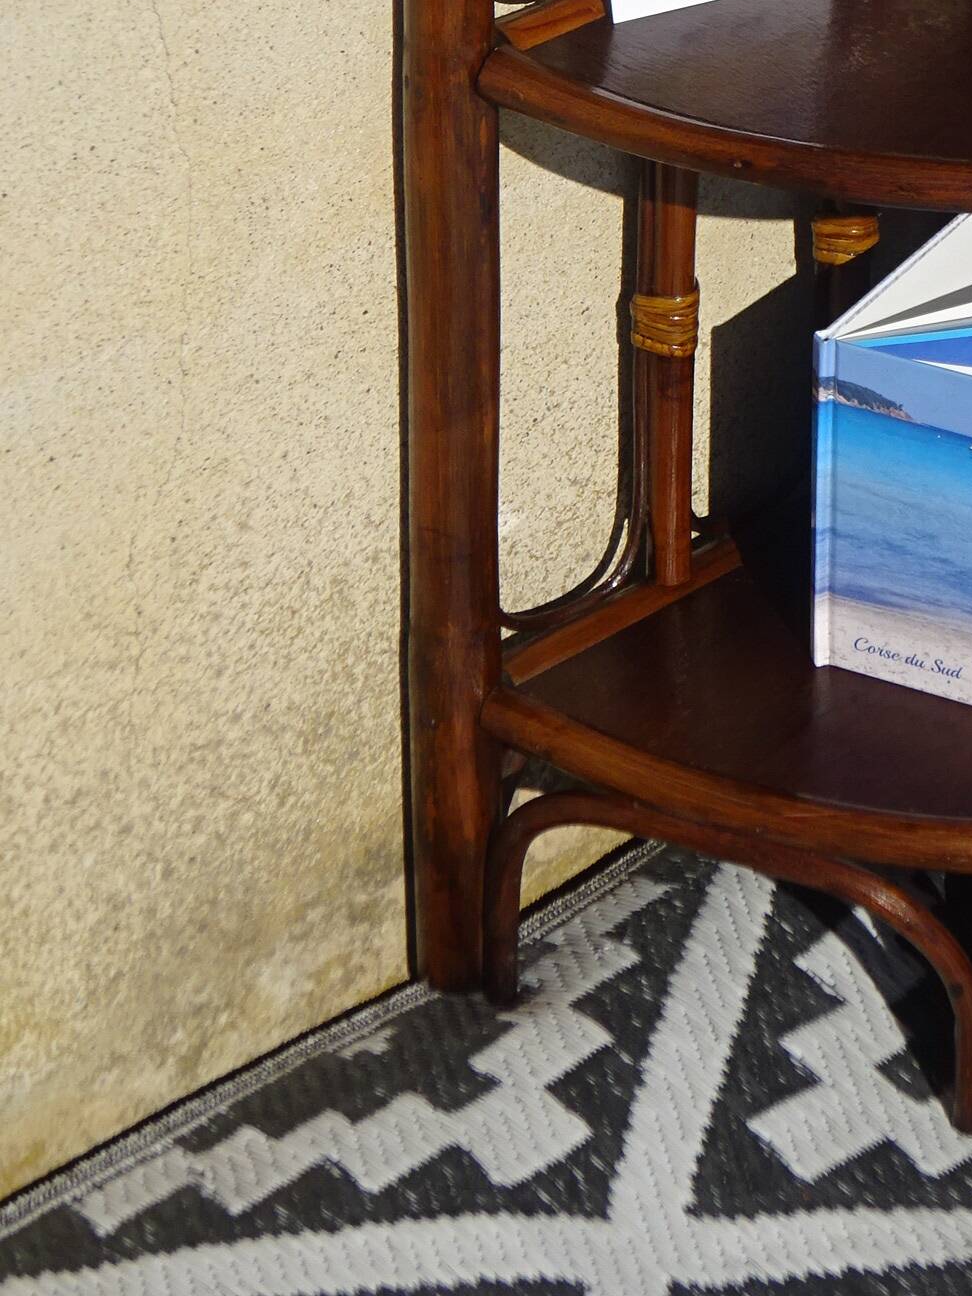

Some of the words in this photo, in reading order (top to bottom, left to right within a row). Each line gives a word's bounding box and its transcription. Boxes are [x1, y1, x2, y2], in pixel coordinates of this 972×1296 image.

[854, 636, 901, 661] Corse
[904, 653, 926, 668] du
[931, 658, 964, 680] Sud
